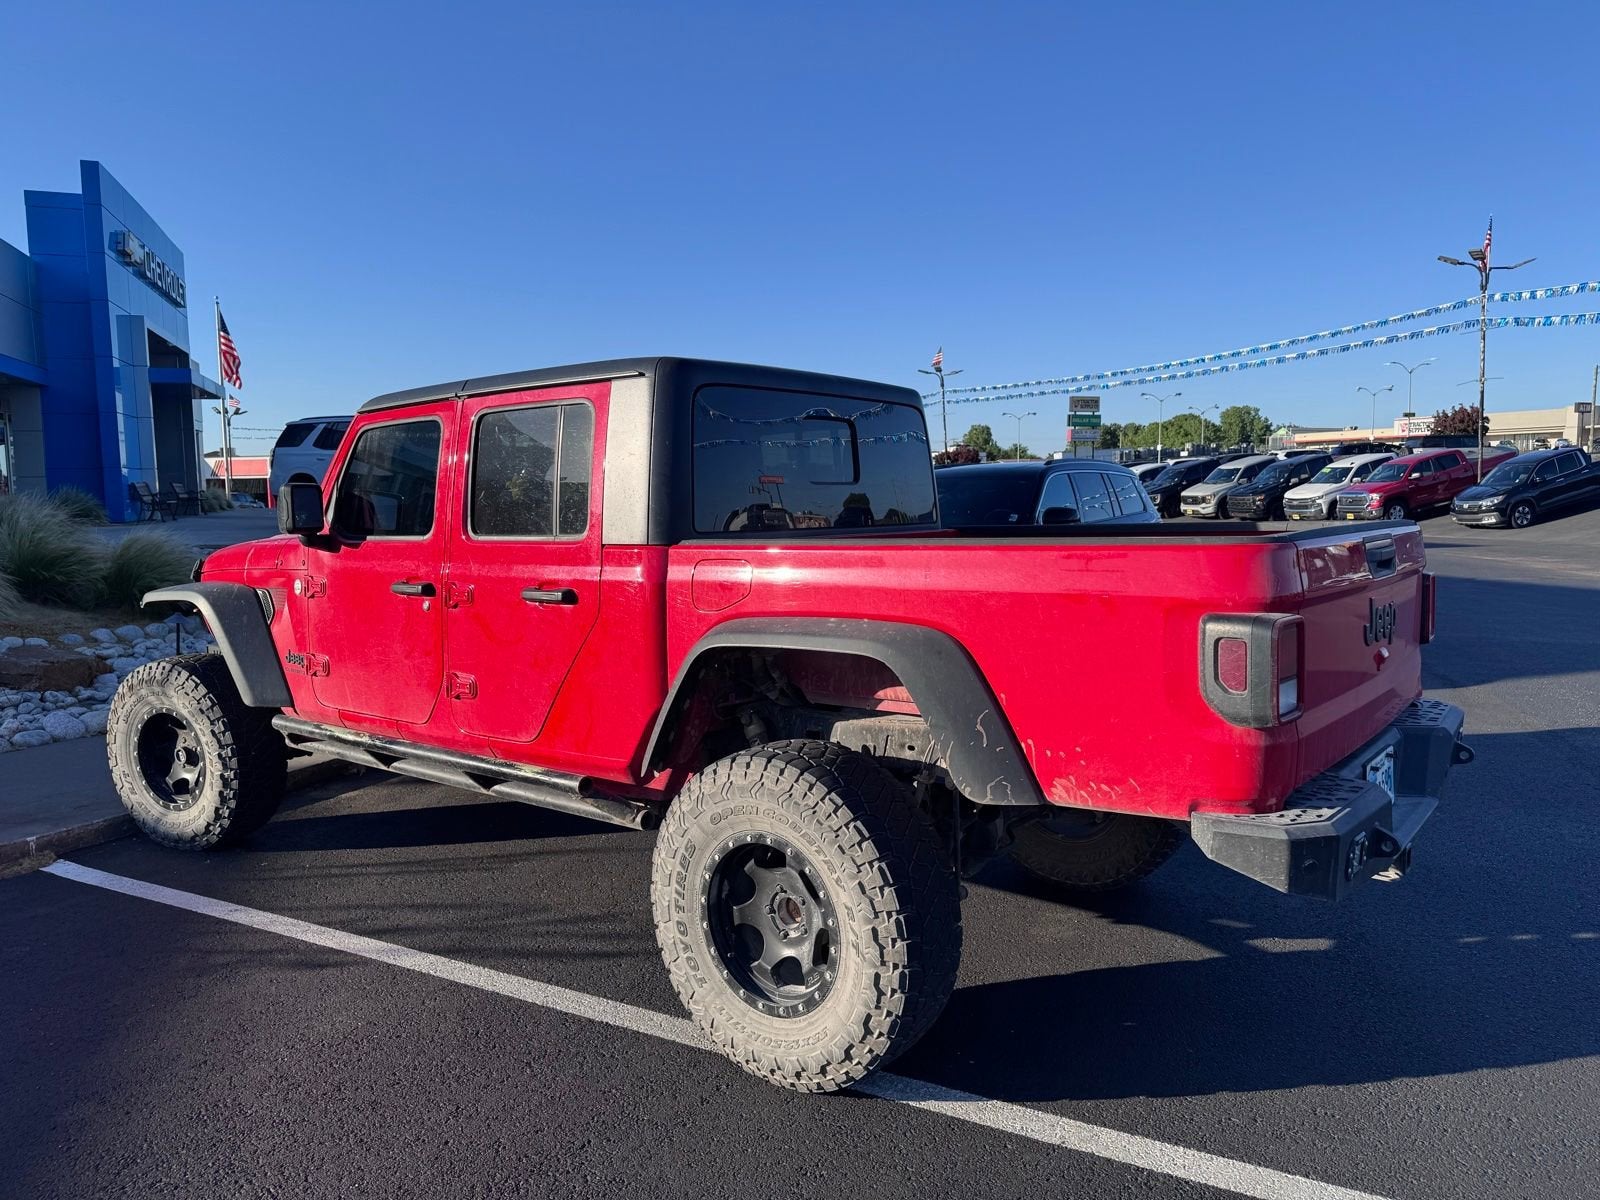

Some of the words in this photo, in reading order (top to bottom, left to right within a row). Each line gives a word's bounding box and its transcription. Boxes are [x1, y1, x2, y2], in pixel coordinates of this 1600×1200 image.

[144, 246, 187, 307] CHEVROLET
[1363, 597, 1396, 647] Jeep
[286, 649, 305, 668] Jeep
[674, 837, 697, 915] TIRES
[710, 805, 759, 826] OPEN
[762, 808, 846, 893] COUNTRY
[675, 919, 708, 989] TOYO
